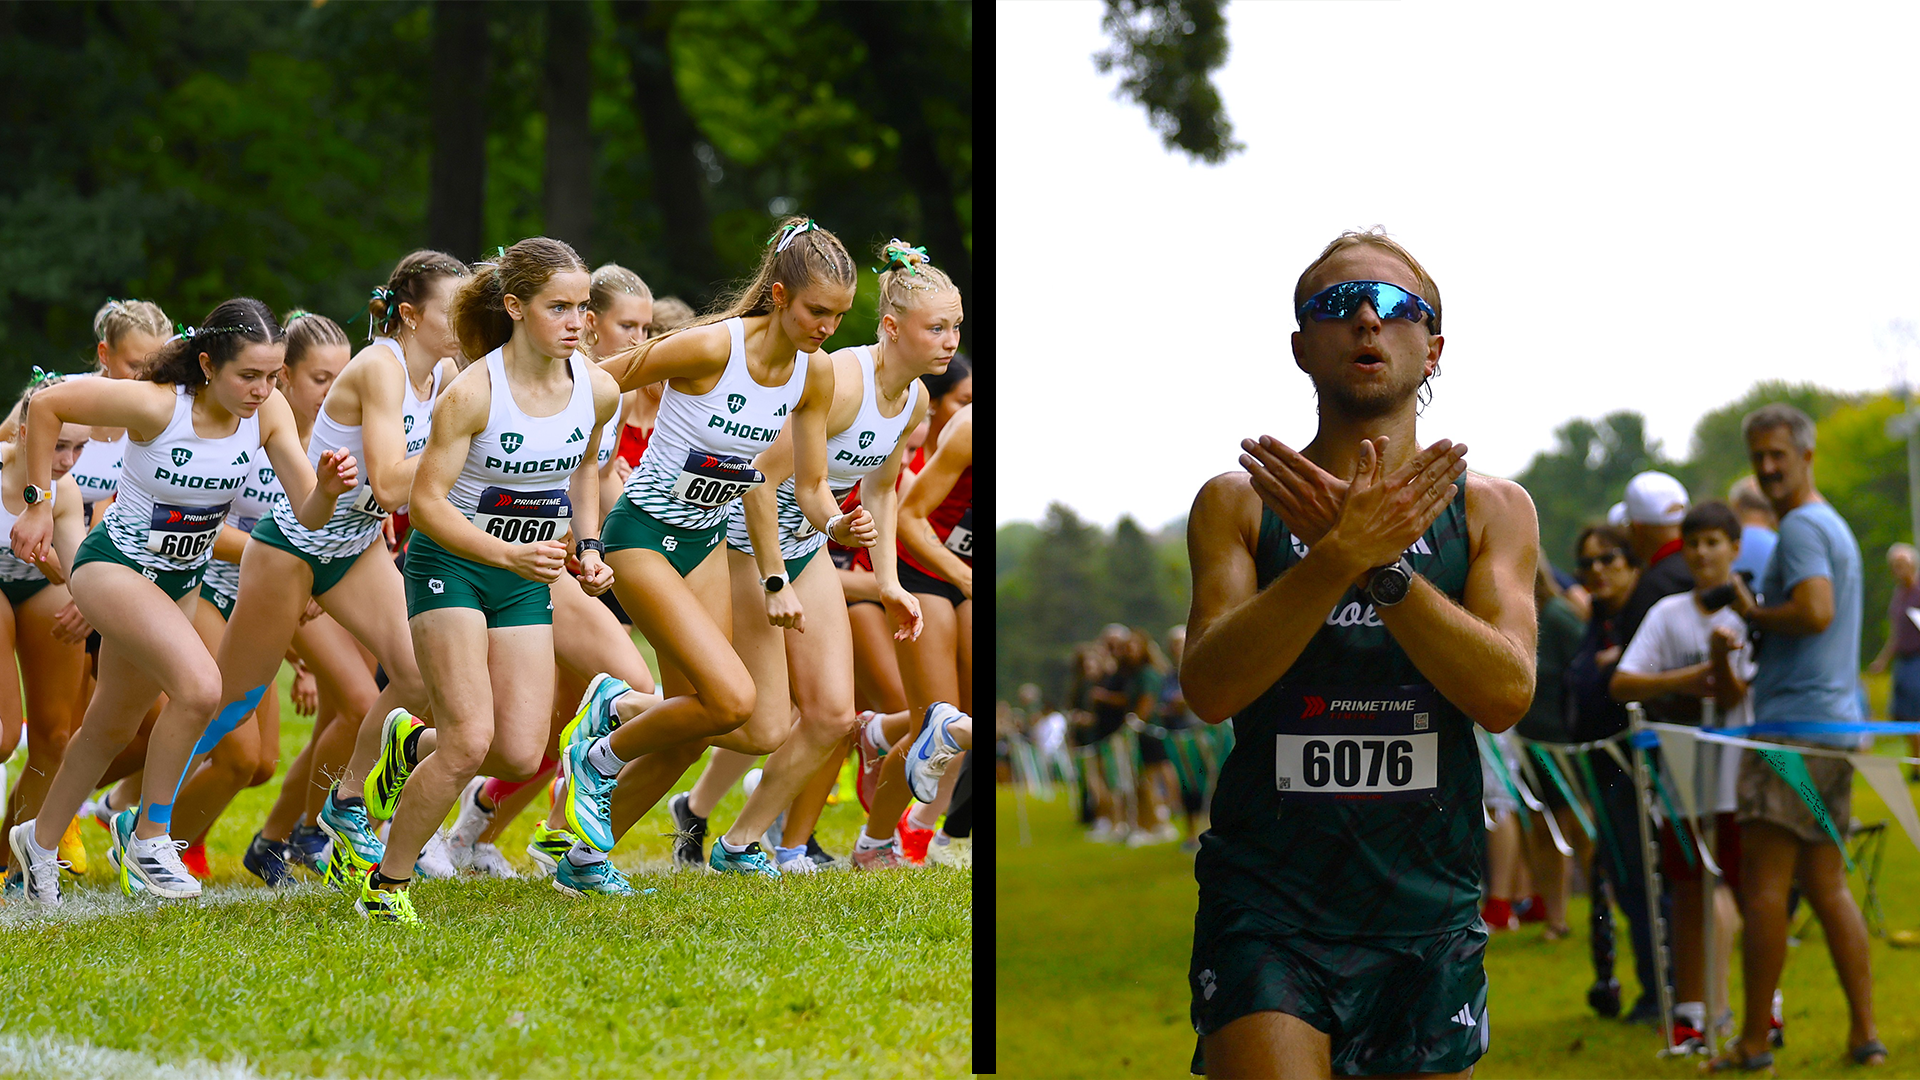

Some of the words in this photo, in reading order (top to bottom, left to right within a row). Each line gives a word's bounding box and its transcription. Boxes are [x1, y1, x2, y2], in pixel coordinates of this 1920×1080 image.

[72, 473, 117, 490] OENI
[685, 478, 751, 504] 6065
[513, 497, 562, 507] PRIMETIME
[485, 517, 557, 544] 6060
[160, 530, 217, 558] 6062
[1329, 699, 1417, 712] PRIMETIME
[1329, 713, 1377, 721] TIMING
[1302, 740, 1414, 788] 6076
